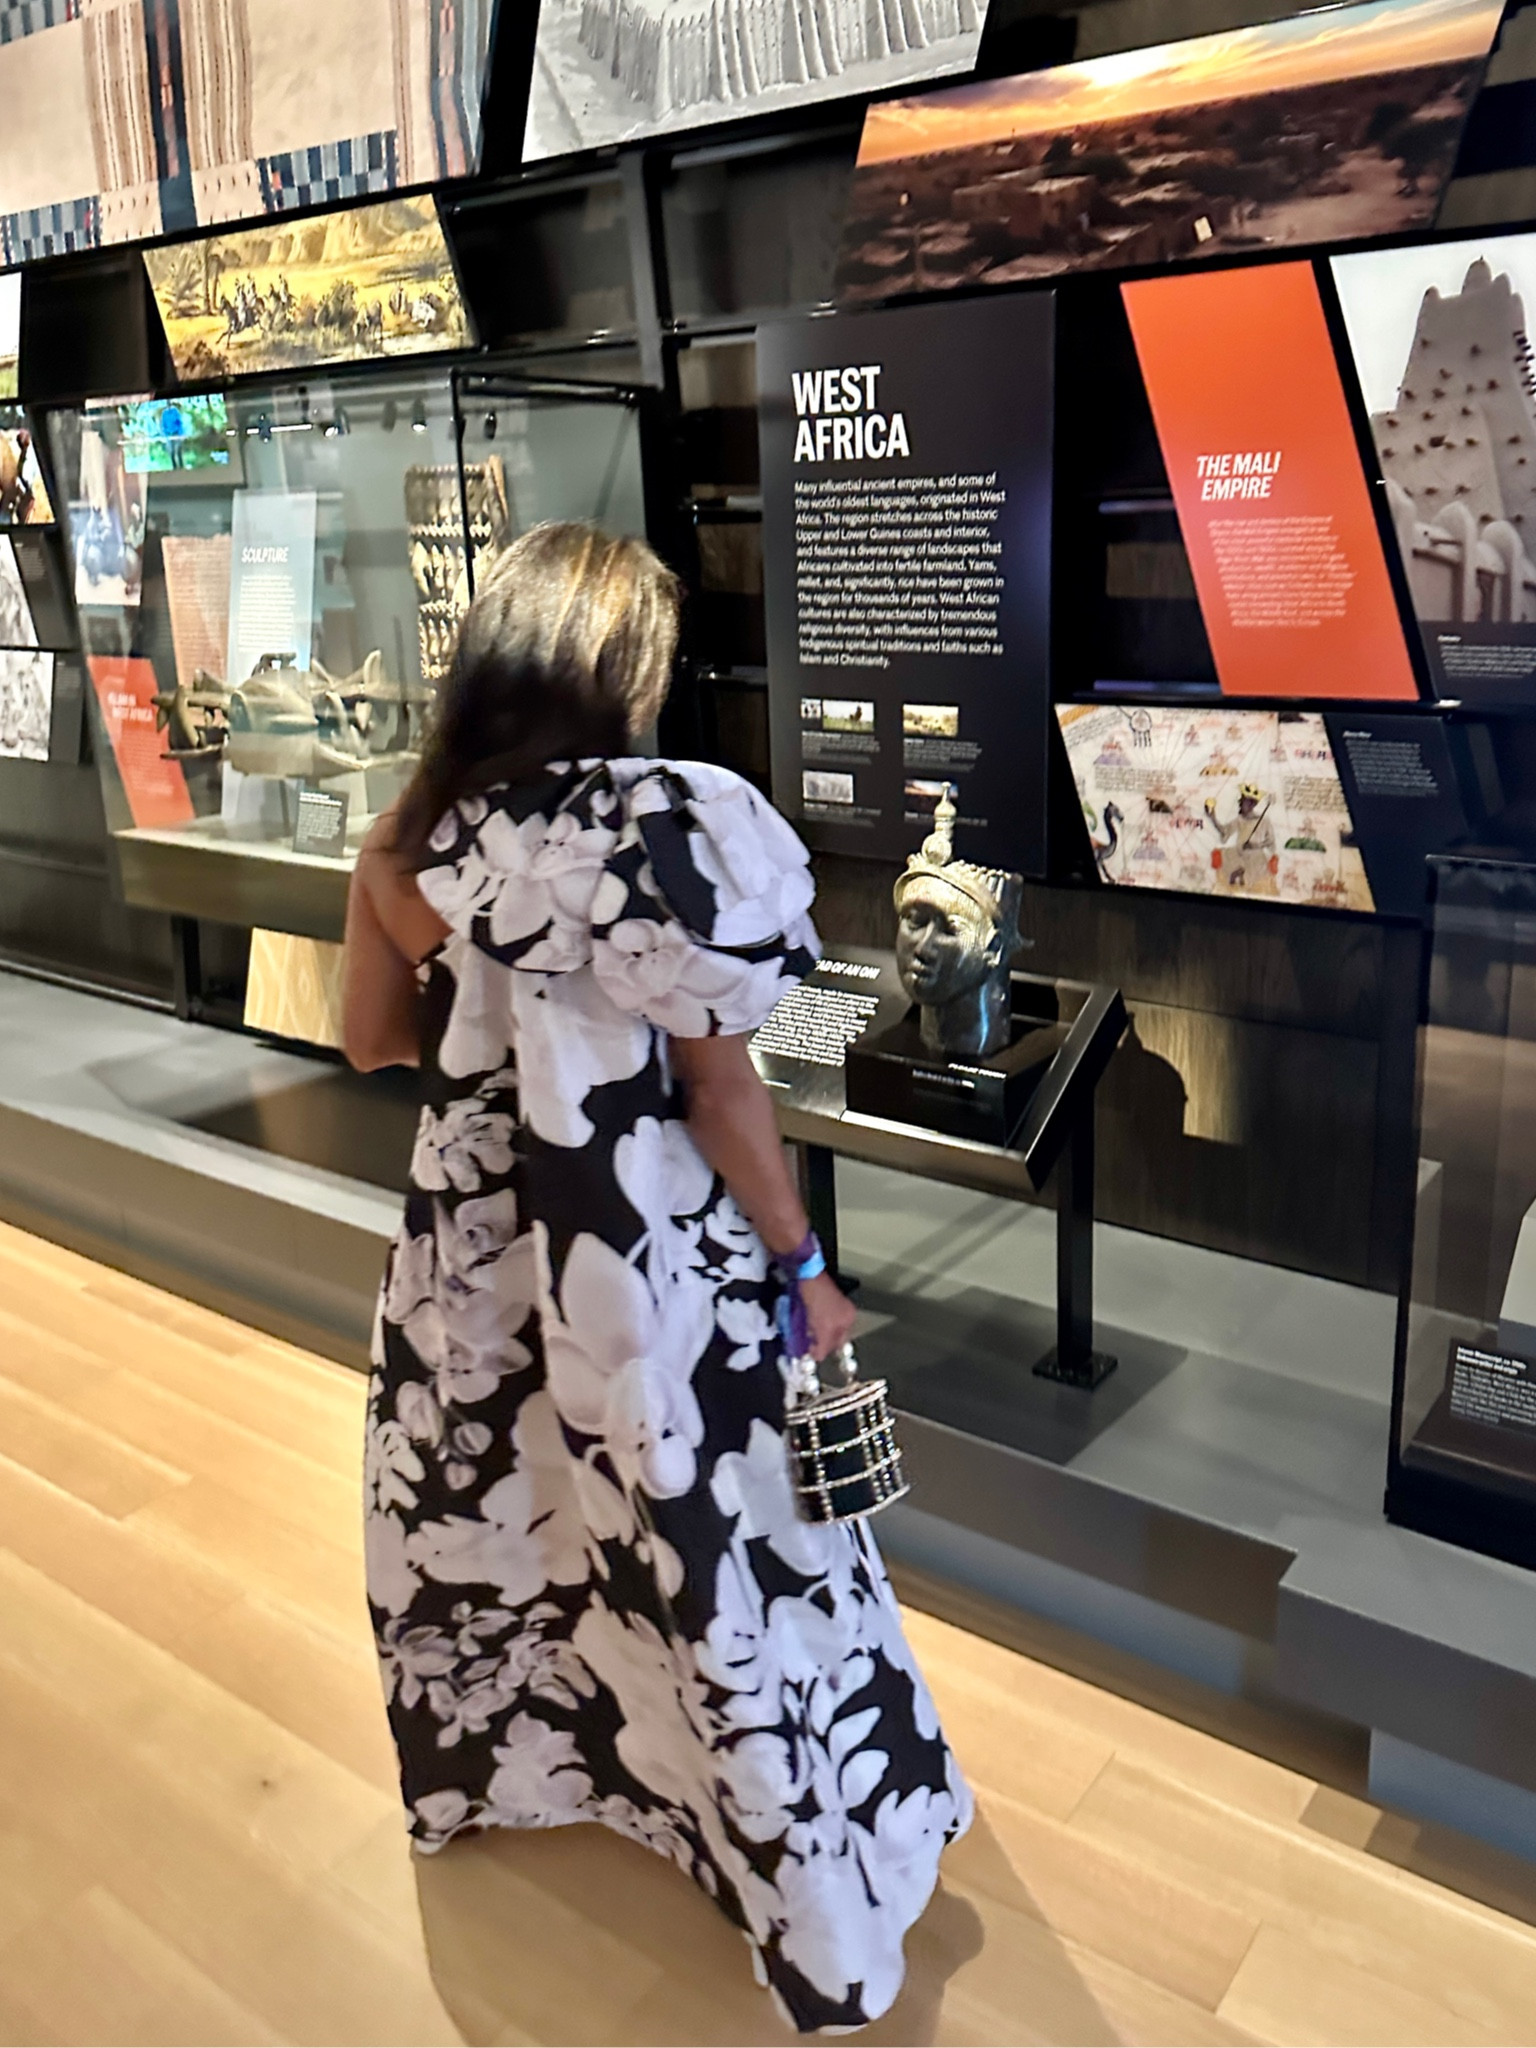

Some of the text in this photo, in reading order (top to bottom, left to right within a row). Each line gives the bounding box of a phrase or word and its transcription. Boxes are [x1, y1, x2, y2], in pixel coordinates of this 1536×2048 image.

[792, 365, 881, 415] WEST
[794, 413, 910, 462] AFRICA
[1197, 450, 1281, 478] THE MALI
[795, 481, 818, 496] Many
[938, 473, 957, 487] and
[958, 475, 984, 487] some
[985, 471, 996, 485] of
[1201, 476, 1273, 501] EMPIRE
[795, 496, 809, 510] the
[842, 495, 869, 508] oldest
[920, 490, 968, 509] originated
[969, 490, 979, 503] in
[980, 489, 1006, 503] West
[824, 512, 840, 525] The
[841, 511, 869, 528] region
[913, 510, 944, 523] across
[945, 508, 960, 521] the
[962, 507, 998, 521] historic
[796, 529, 822, 544] Upper
[823, 528, 840, 541] and
[841, 528, 868, 541] Lower
[902, 526, 932, 539] coasts
[934, 524, 952, 539] and
[241, 546, 289, 563] SCULPTURE
[796, 545, 813, 558] and
[916, 542, 926, 556] of
[928, 541, 980, 558] landscapes
[981, 541, 1002, 554] that
[876, 560, 894, 572] into
[898, 576, 914, 589] rice
[915, 575, 937, 588] have
[938, 574, 962, 588] been
[963, 577, 994, 591] grown
[995, 576, 1005, 588] in
[841, 591, 853, 604] for
[854, 591, 900, 605] thousands
[901, 590, 911, 605] of
[939, 591, 964, 605] West
[965, 590, 1000, 606] African
[927, 606, 940, 624] by
[940, 607, 997, 622] tremendous
[941, 622, 963, 637] from
[964, 624, 998, 639] various
[923, 639, 941, 653] and
[968, 640, 991, 655] such
[823, 652, 839, 665] and
